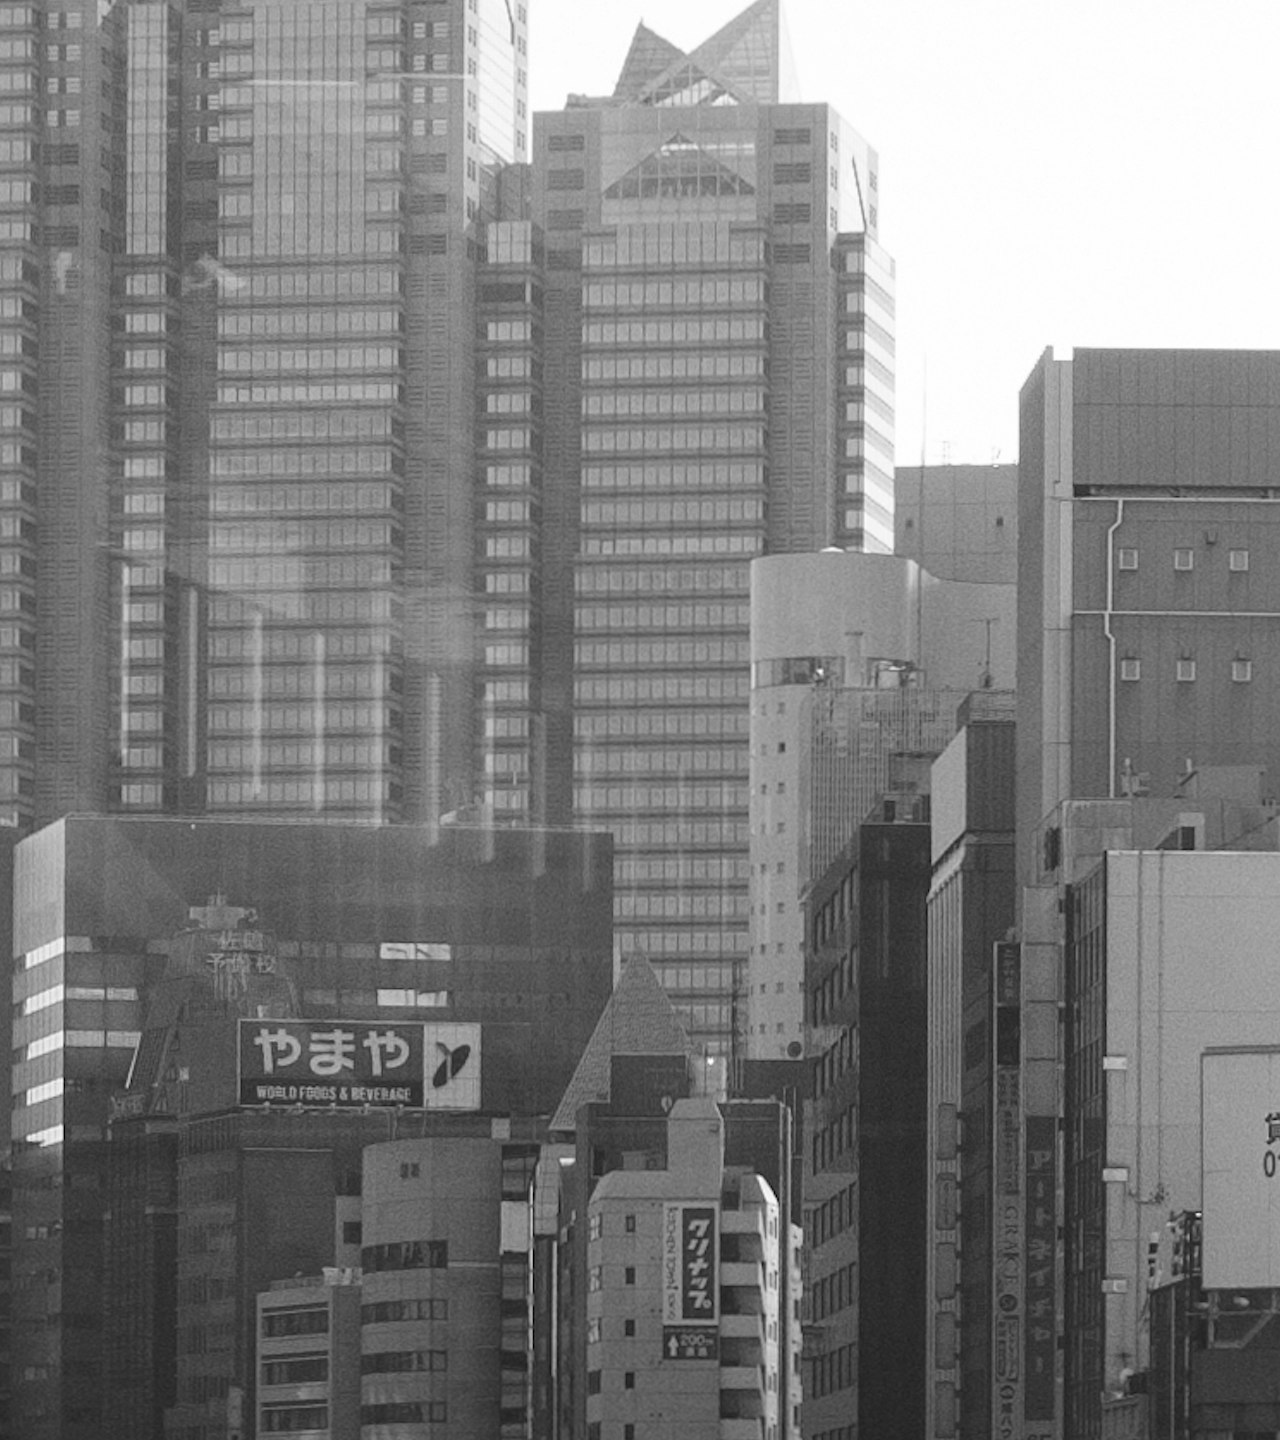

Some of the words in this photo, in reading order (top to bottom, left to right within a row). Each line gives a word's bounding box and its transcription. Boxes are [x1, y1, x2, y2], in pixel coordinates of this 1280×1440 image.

[253, 1028, 411, 1077] やまや
[256, 1085, 297, 1101] WORLD
[300, 1085, 336, 1101] FOODS
[338, 1085, 349, 1101] &
[351, 1085, 412, 1102] BEVERAGE
[687, 1218, 712, 1310] クリナップ
